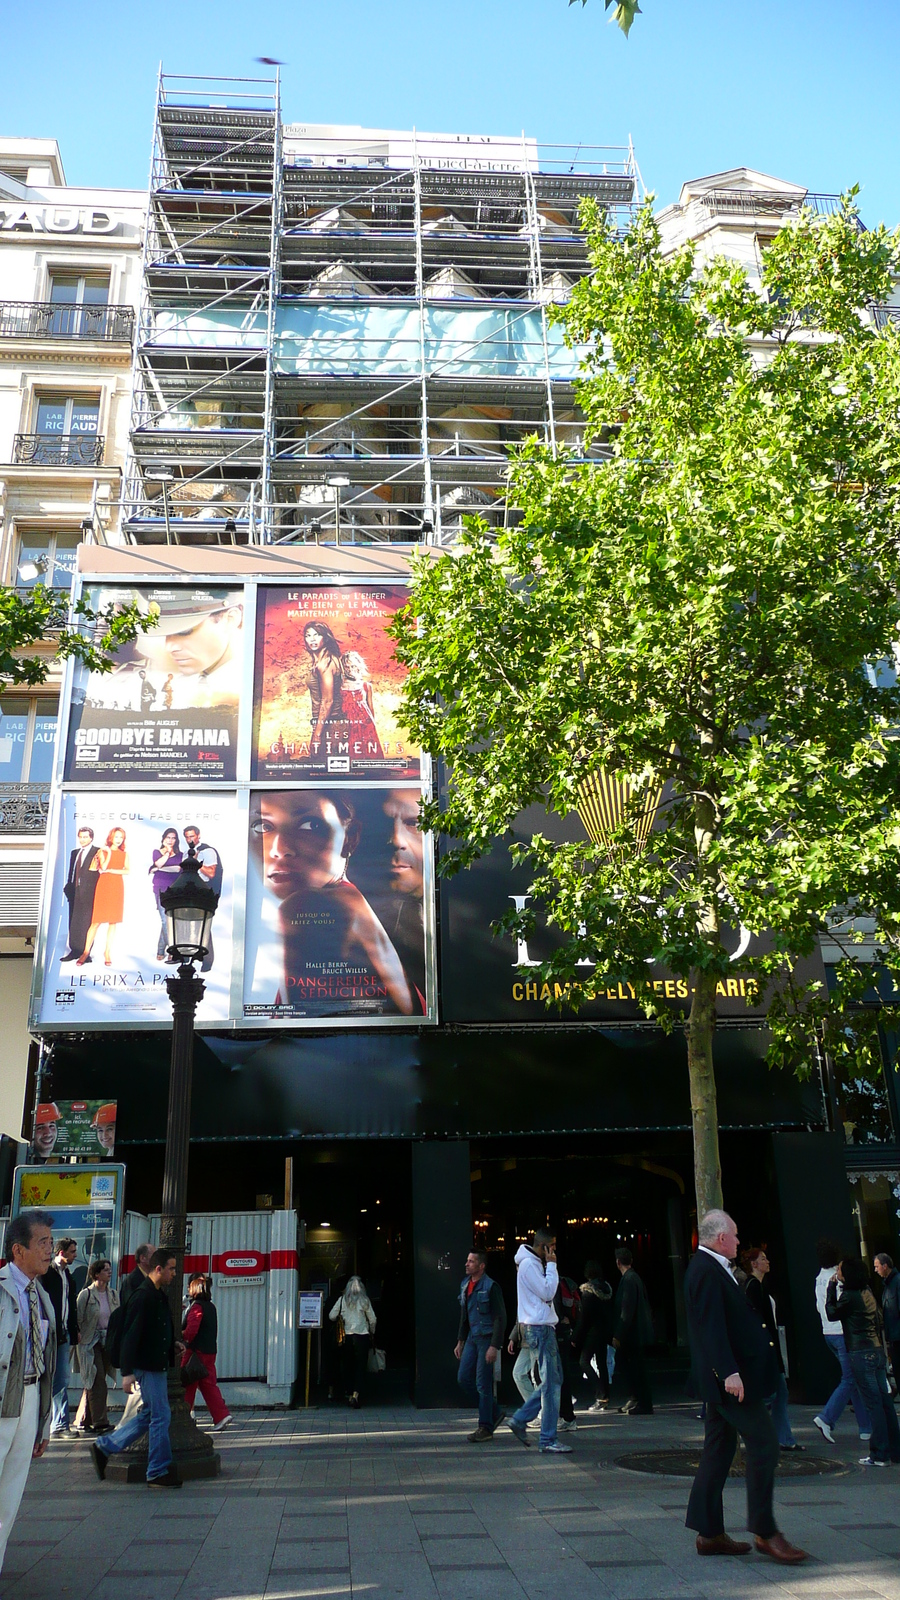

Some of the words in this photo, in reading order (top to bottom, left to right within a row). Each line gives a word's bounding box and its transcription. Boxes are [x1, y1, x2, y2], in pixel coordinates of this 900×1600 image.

[287, 592, 299, 600] LE
[302, 592, 339, 600] PARADIS
[354, 592, 387, 600] L'ENFER
[298, 601, 309, 609] LE
[312, 601, 333, 609] BIEN
[348, 601, 359, 609] LE
[361, 601, 379, 609] MAL
[287, 610, 341, 618] MAINTENANT
[356, 610, 388, 618] JAMAIS
[6, 722, 26, 730] LAB.
[74, 728, 155, 746] GOODBYE
[159, 729, 230, 747] BAFANA
[326, 731, 349, 740] LES
[120, 812, 144, 821] CUL
[150, 812, 171, 821] PAS
[70, 975, 87, 987] LE
[93, 974, 128, 987] PRIX
[134, 971, 145, 986] À
[285, 976, 377, 987] DANGEREUSE
[715, 978, 759, 997] ARIS
[57, 993, 75, 1001] dts
[300, 986, 388, 999] SEDUCTION
